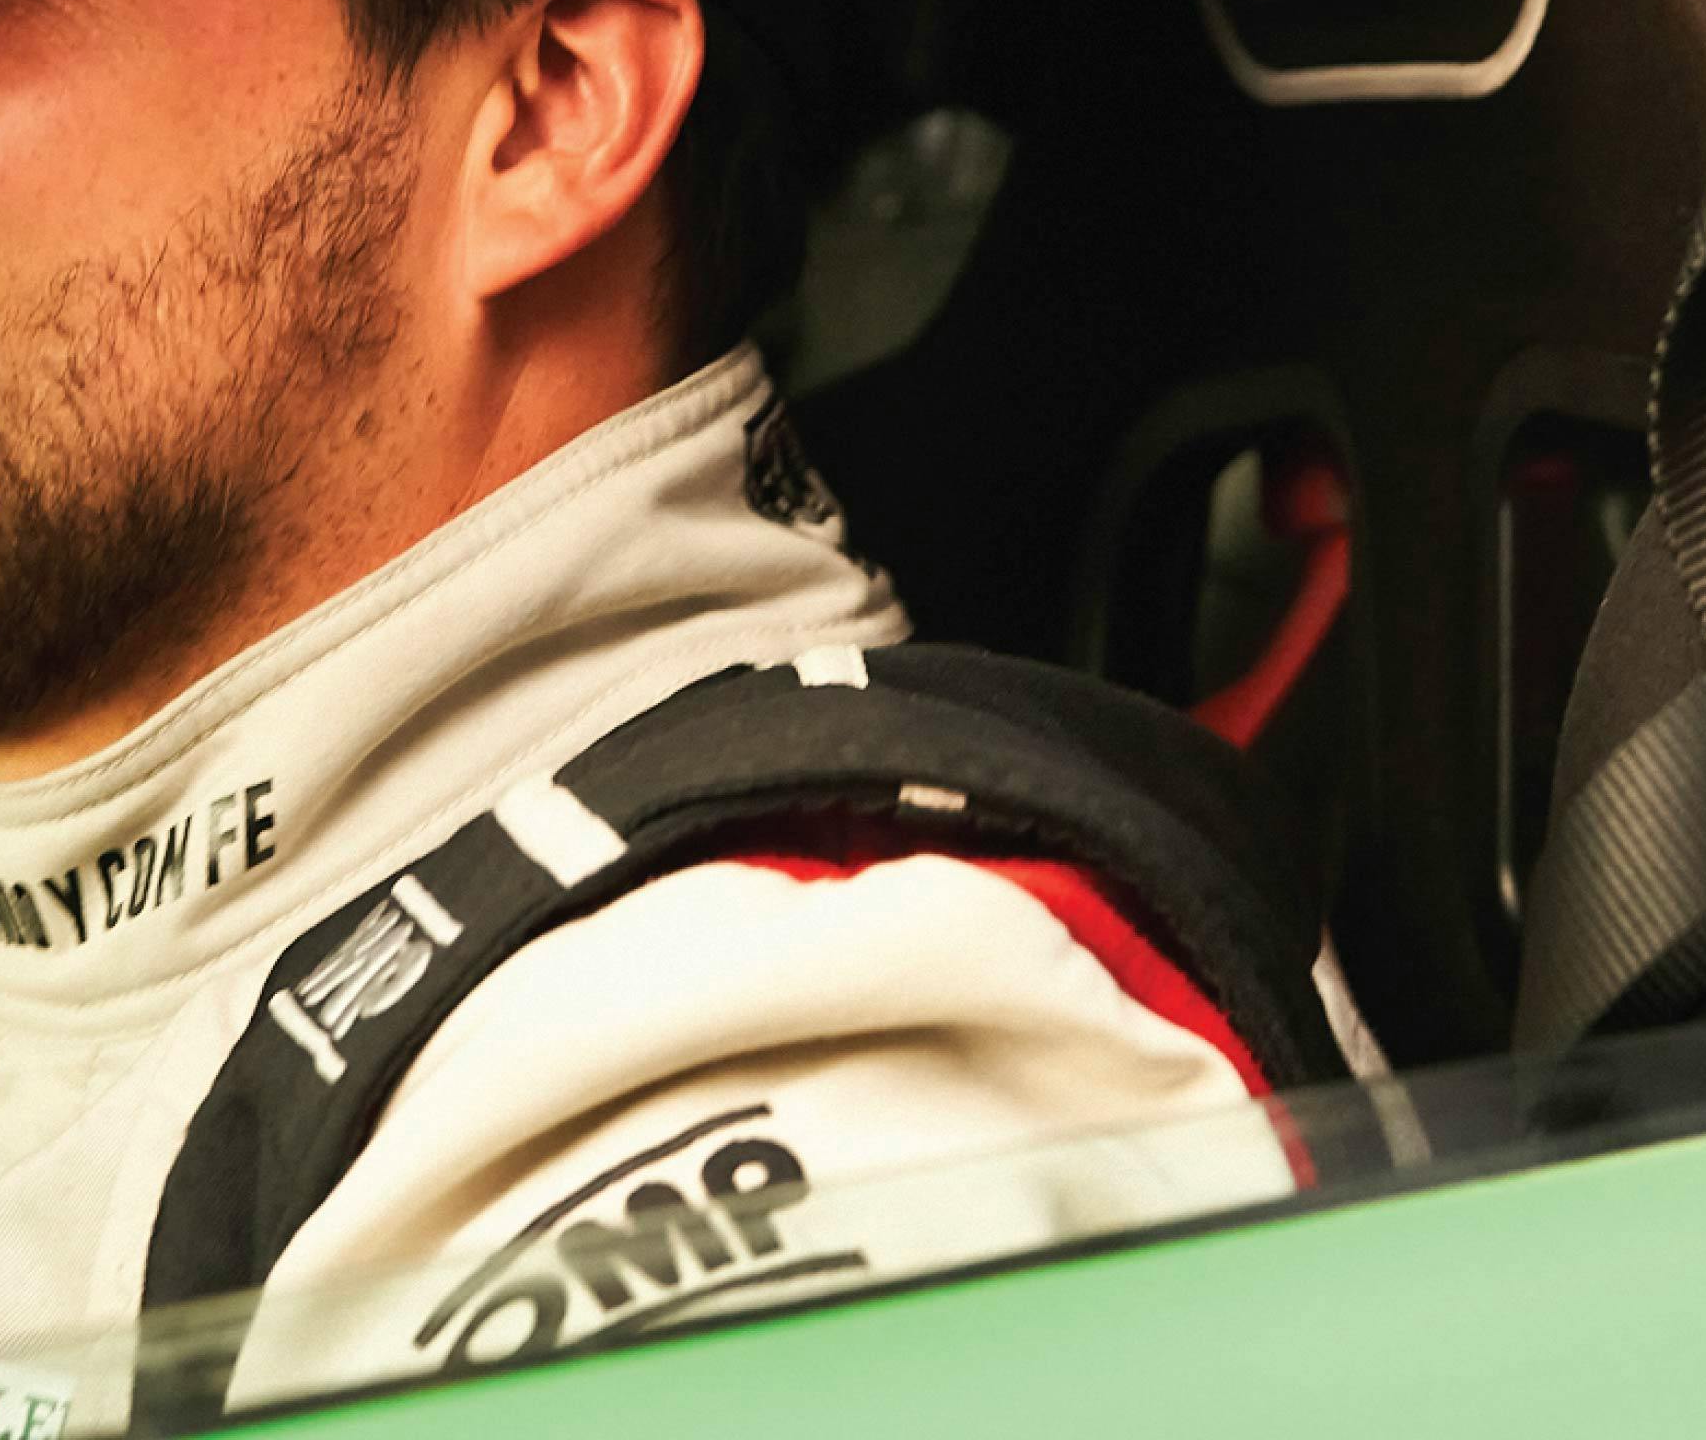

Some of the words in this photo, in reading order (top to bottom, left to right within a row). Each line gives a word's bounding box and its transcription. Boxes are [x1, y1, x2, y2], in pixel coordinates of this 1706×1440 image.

[39, 866, 89, 946] Y
[95, 813, 193, 931] CON
[205, 777, 277, 888] FE
[441, 1136, 810, 1370] OMP
